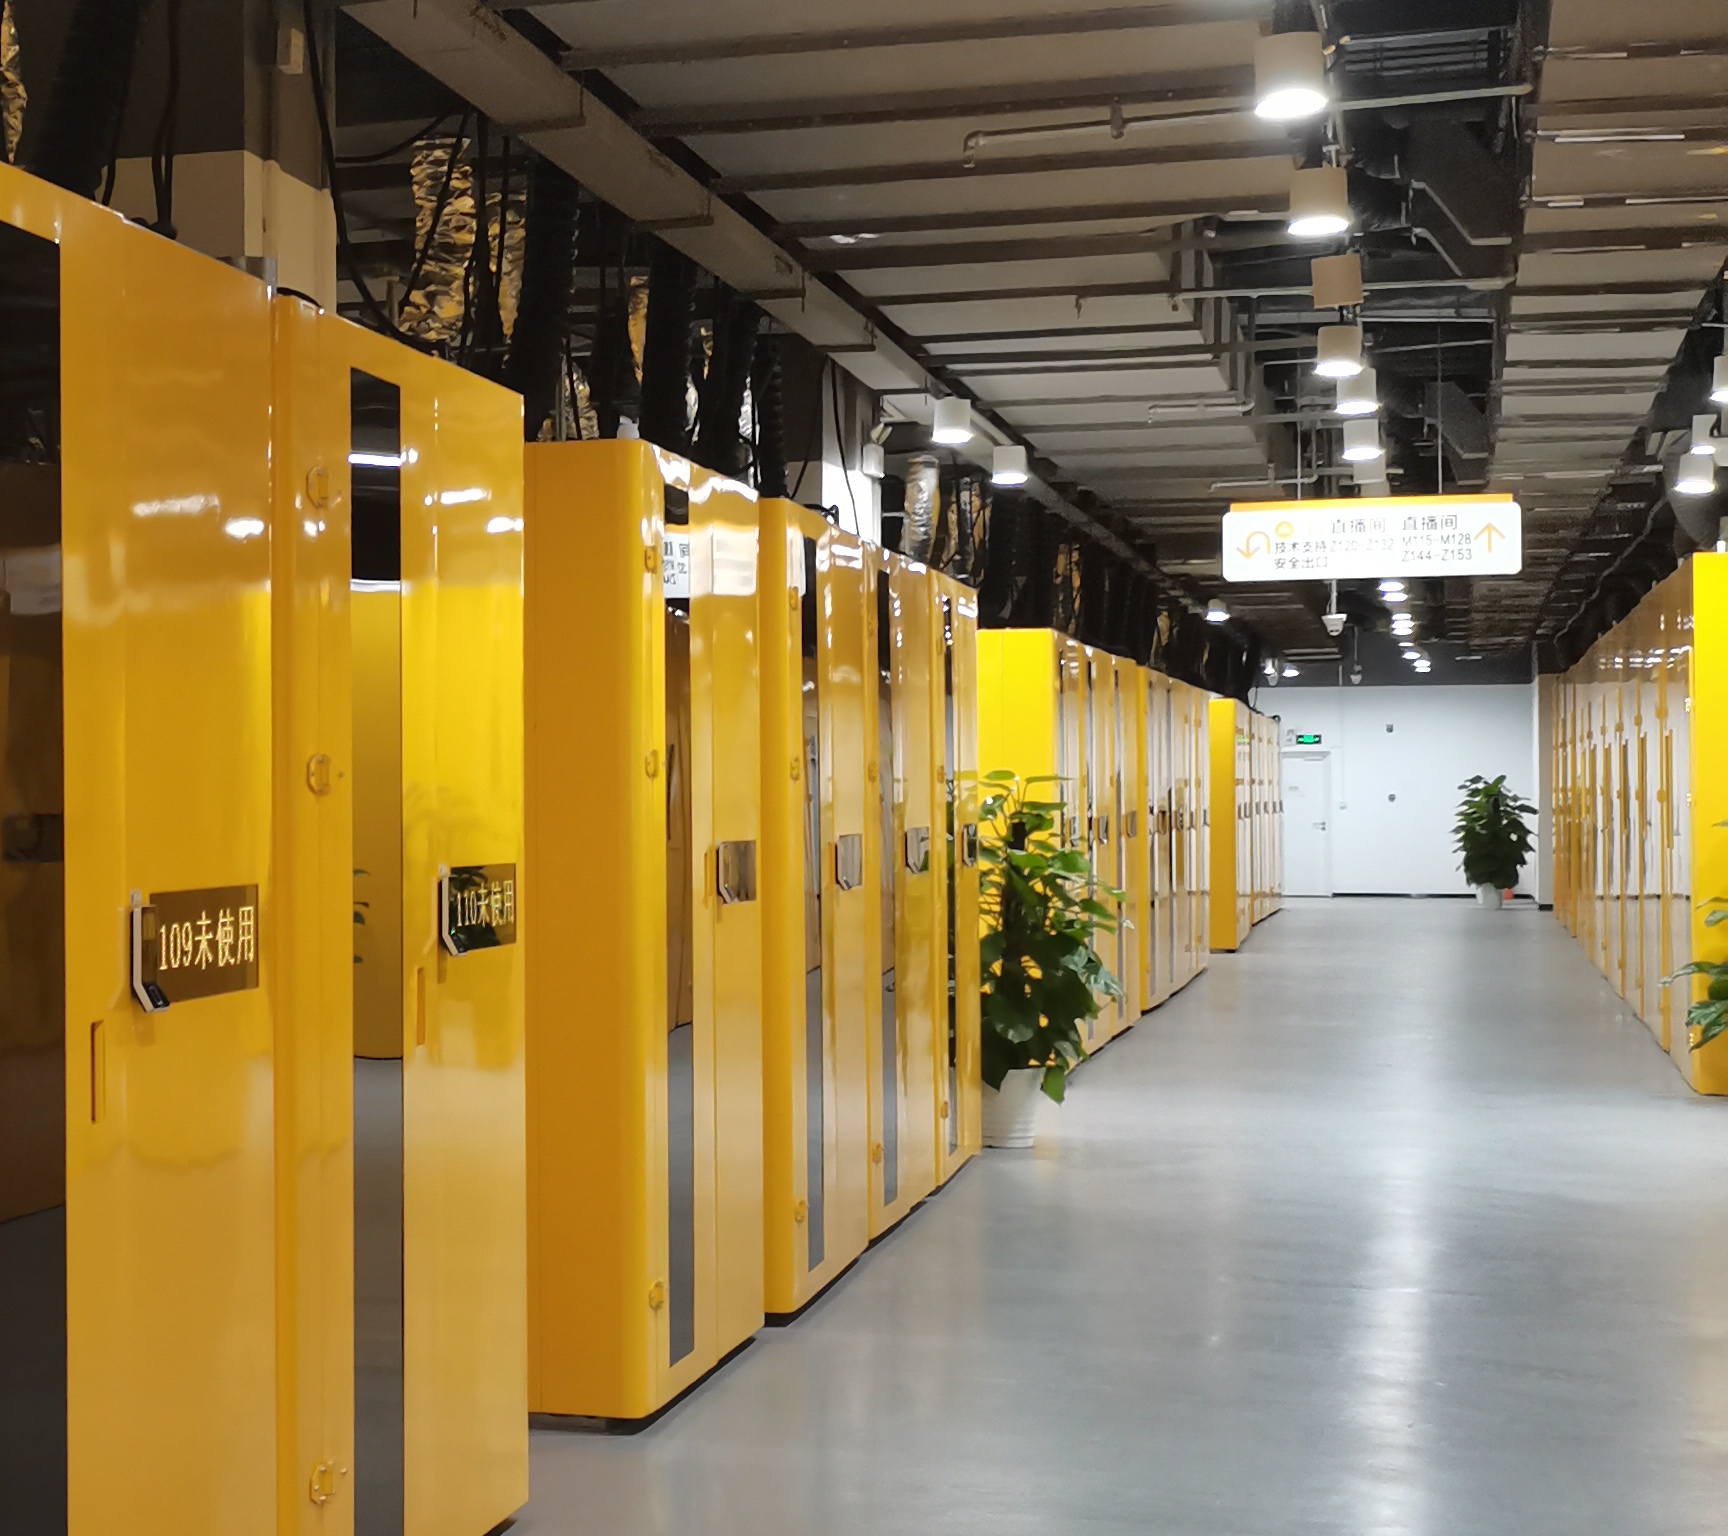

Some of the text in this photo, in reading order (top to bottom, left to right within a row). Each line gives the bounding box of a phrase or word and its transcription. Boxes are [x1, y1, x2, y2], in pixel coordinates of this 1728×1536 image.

[1330, 518, 1386, 534] 直播间
[1402, 514, 1458, 531] 直播间
[1402, 532, 1472, 547] M115-M128
[1273, 556, 1328, 570] 安全出口
[1401, 547, 1473, 563] Z144-Z153
[158, 905, 255, 971] 109未使用
